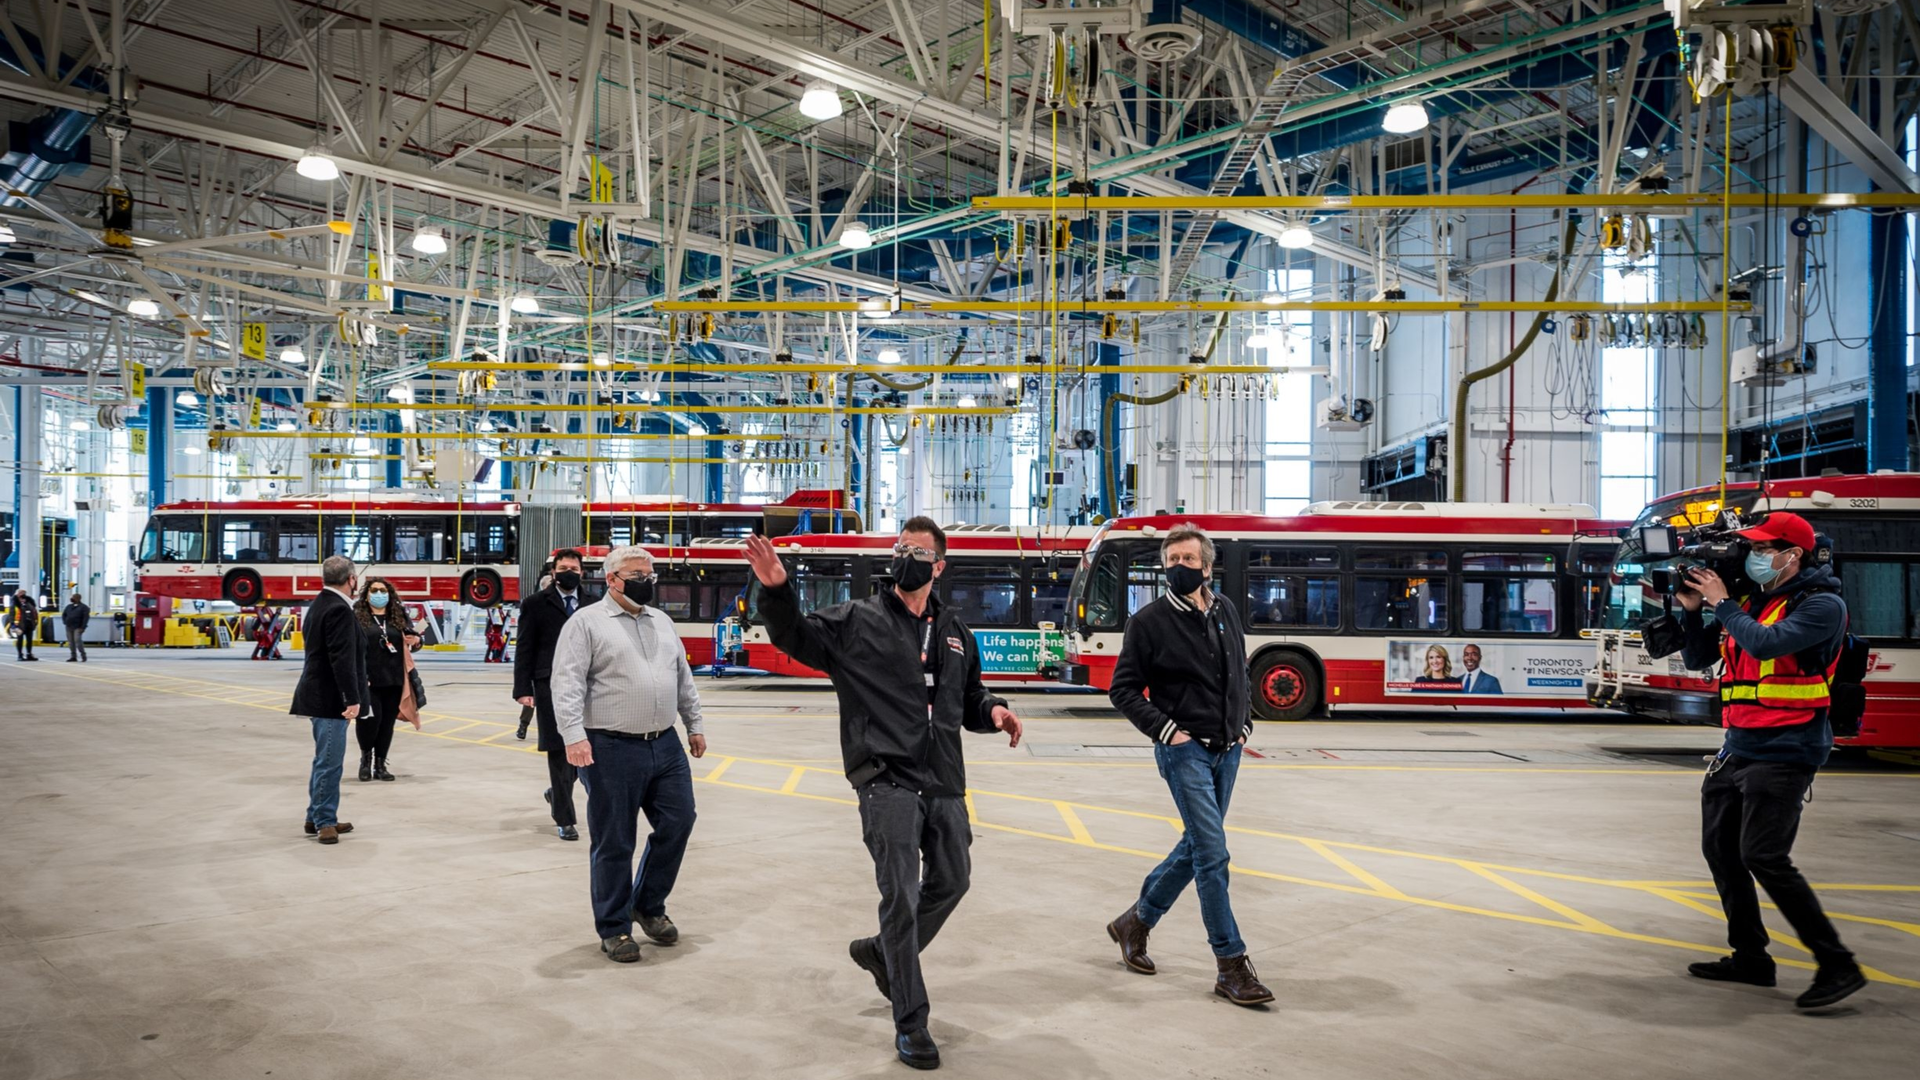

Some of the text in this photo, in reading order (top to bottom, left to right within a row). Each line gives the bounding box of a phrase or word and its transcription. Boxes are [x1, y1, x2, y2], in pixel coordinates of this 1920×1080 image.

[248, 324, 262, 343] 13
[133, 433, 144, 445] 19
[1849, 498, 1876, 508] 3202
[983, 635, 1064, 649] Life happens
[983, 651, 1060, 662] We can hp
[1527, 658, 1583, 667] TORONTO'S
[1538, 667, 1592, 676] NEWSCAST
